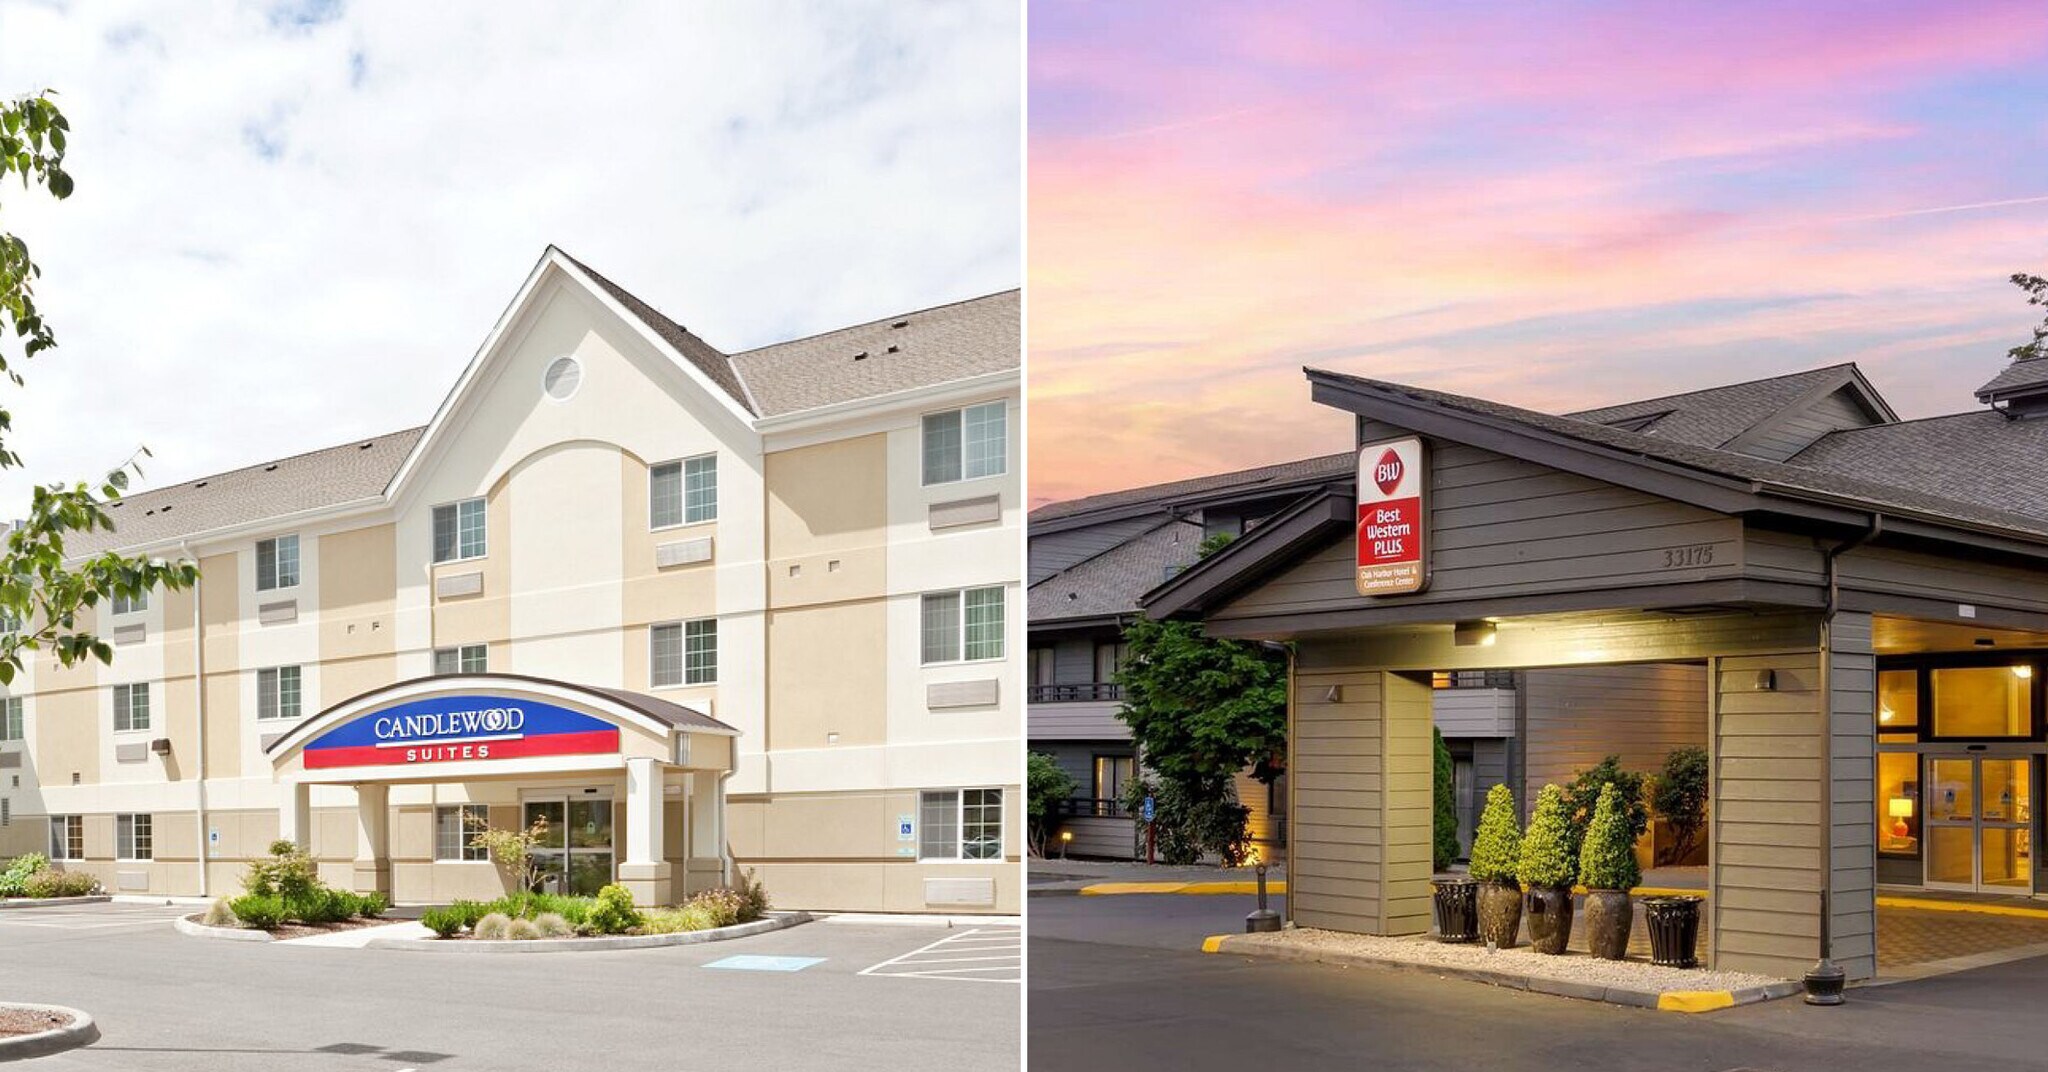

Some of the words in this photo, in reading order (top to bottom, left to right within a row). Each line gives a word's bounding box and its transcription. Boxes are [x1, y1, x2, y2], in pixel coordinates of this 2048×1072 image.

[1378, 462, 1400, 482] BW
[1377, 508, 1401, 524] Best
[1367, 523, 1411, 540] Western
[1664, 545, 1714, 568] 33175
[375, 708, 525, 739] CANDLEWOOD
[407, 745, 490, 762] SUITES
